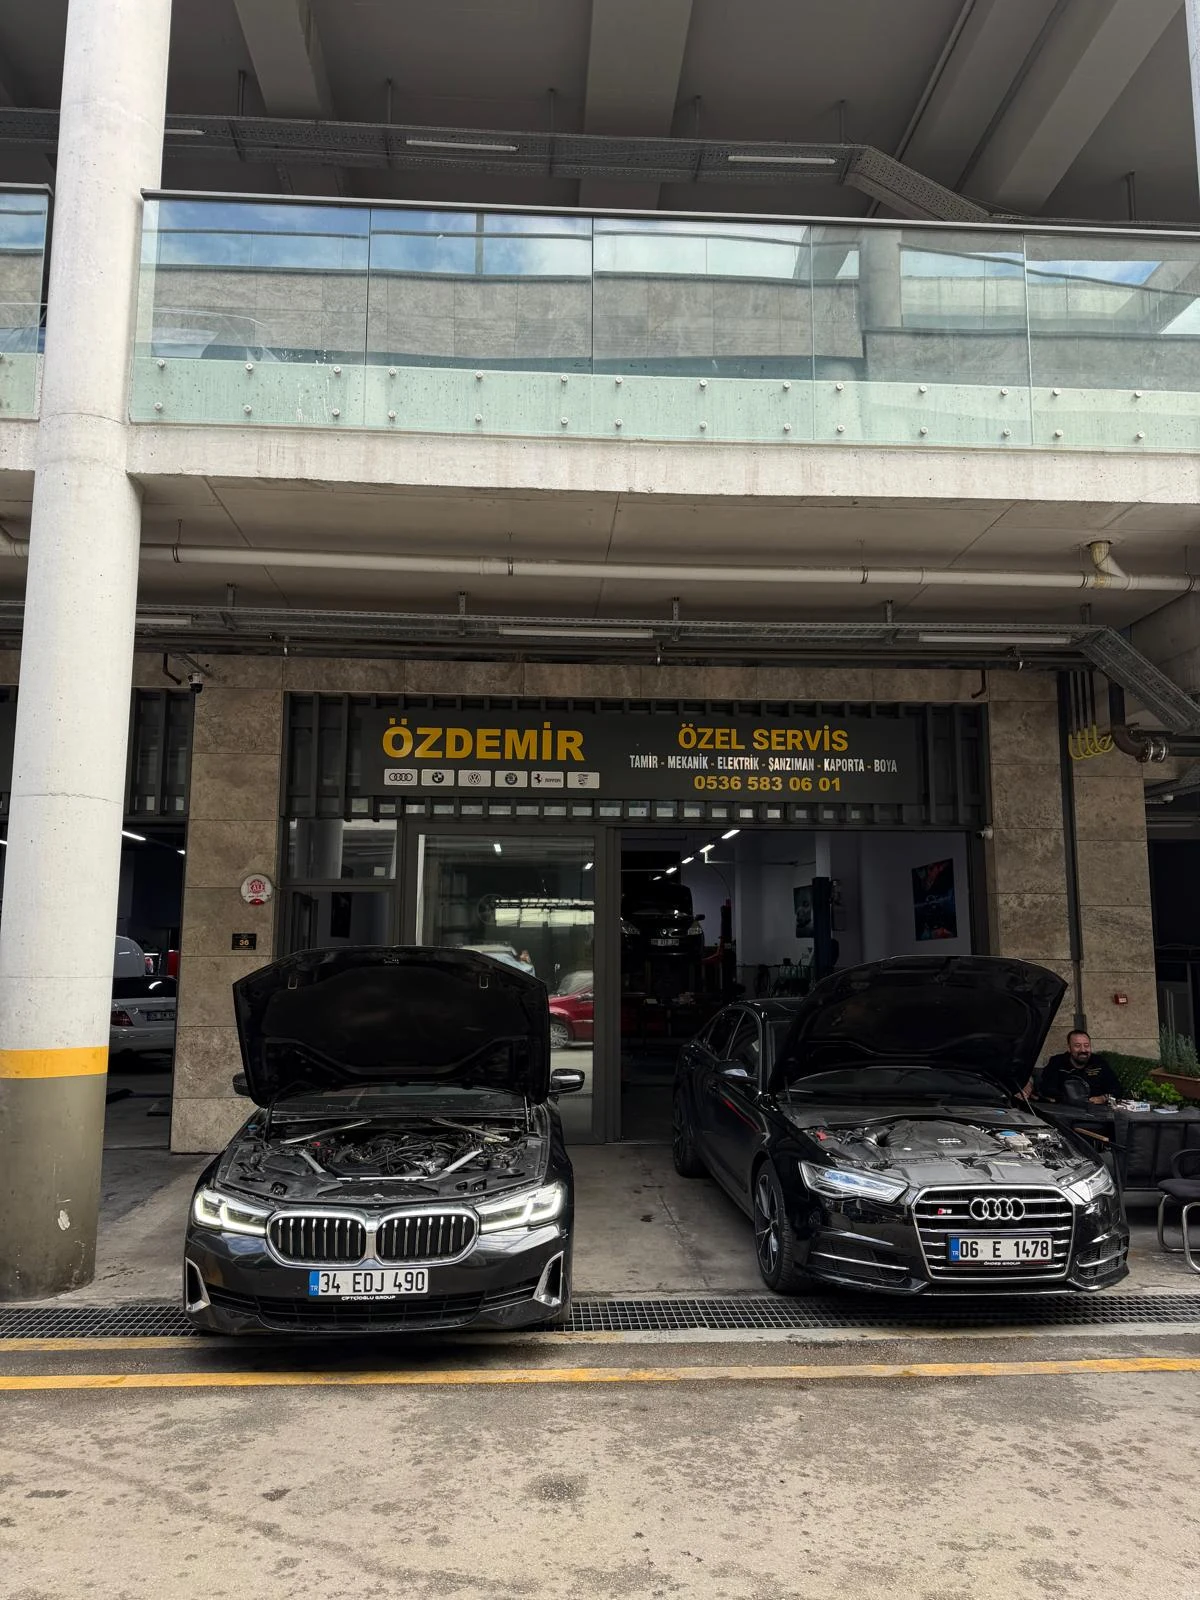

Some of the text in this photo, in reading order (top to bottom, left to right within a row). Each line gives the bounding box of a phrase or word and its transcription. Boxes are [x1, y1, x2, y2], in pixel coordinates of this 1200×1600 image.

[382, 717, 586, 762] ÖZDEMİR
[678, 723, 849, 753] ÖZEL SERVİS
[629, 752, 658, 769] TAMİR
[667, 753, 709, 770] MEKANİK
[717, 754, 759, 771] ELEKTRİK
[768, 757, 815, 773] ŞANZIMAN
[824, 757, 865, 773] KAPORTA
[874, 759, 898, 773] BOYA
[694, 775, 842, 792] 0536 583 06 01
[960, 1240, 978, 1258] 06
[992, 1240, 1002, 1258] E
[1013, 1240, 1049, 1258] 1478
[320, 1272, 341, 1293] 34
[352, 1272, 385, 1293] EDJ
[393, 1271, 425, 1292] 490
